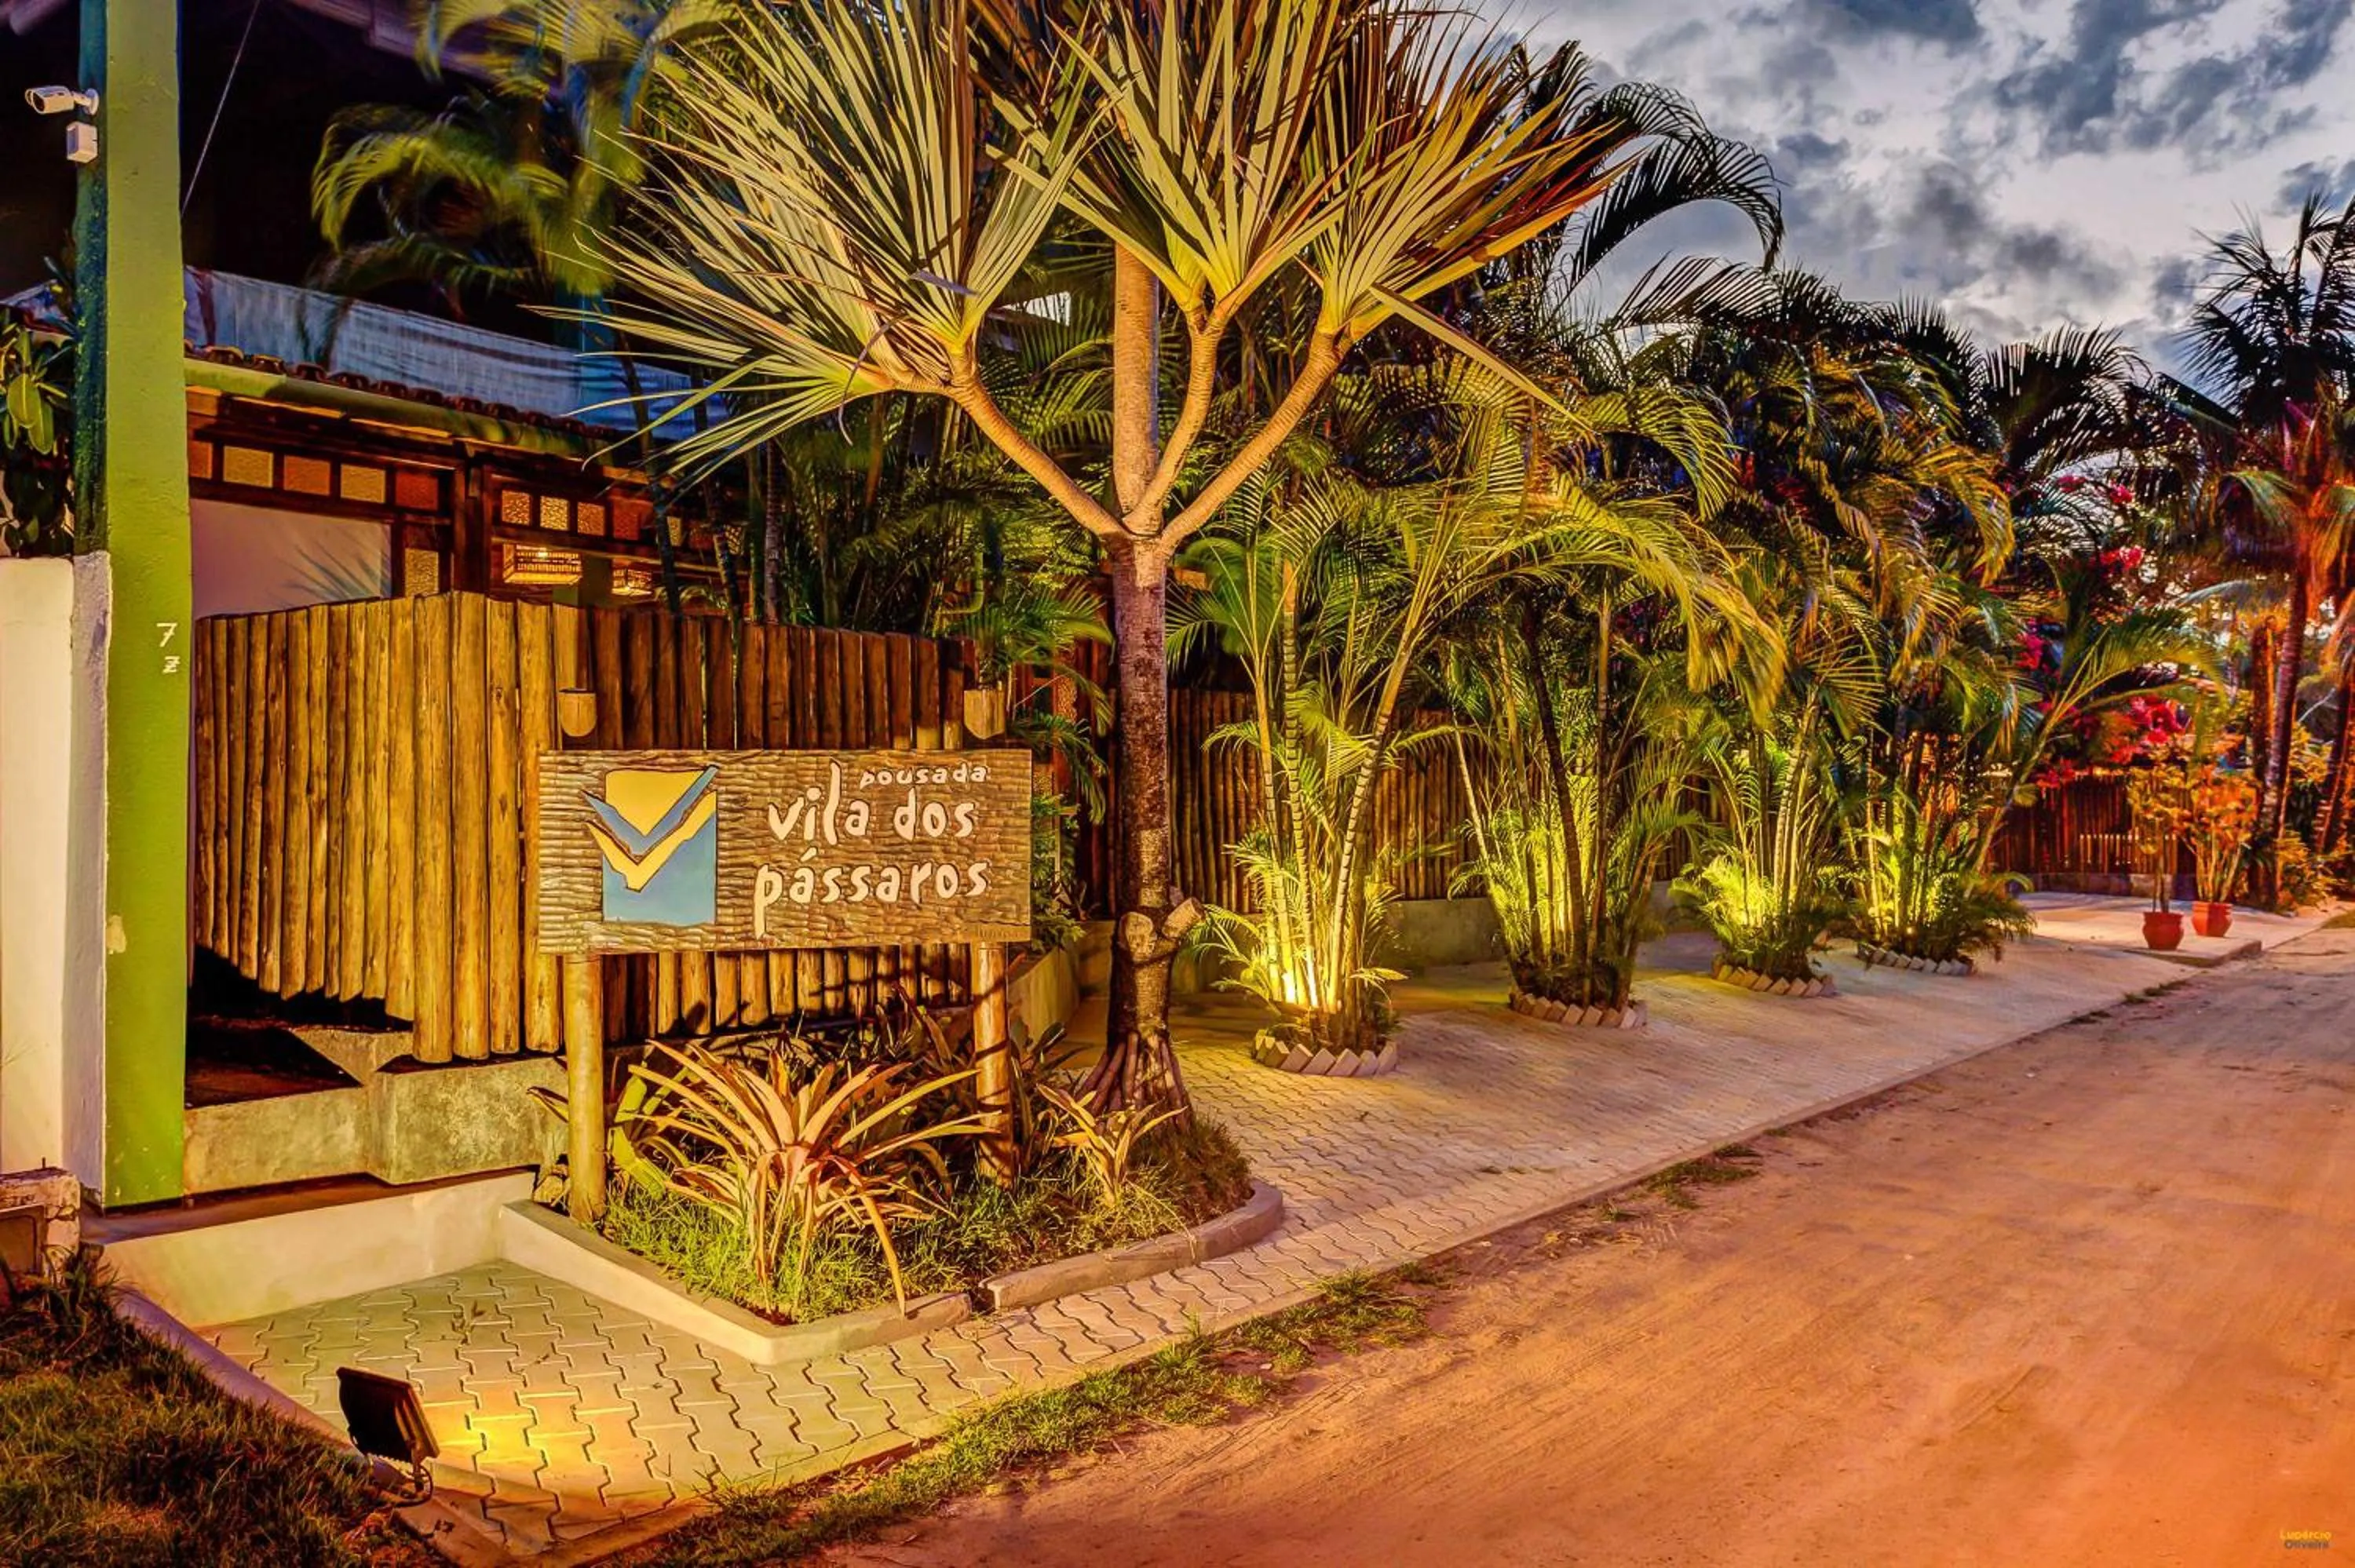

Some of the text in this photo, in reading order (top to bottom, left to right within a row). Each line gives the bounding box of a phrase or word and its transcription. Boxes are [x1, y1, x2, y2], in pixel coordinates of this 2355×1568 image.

[156, 622, 178, 647] 7
[768, 760, 977, 847] vila dos
[860, 762, 989, 790] pousada
[754, 846, 989, 939] pássaros
